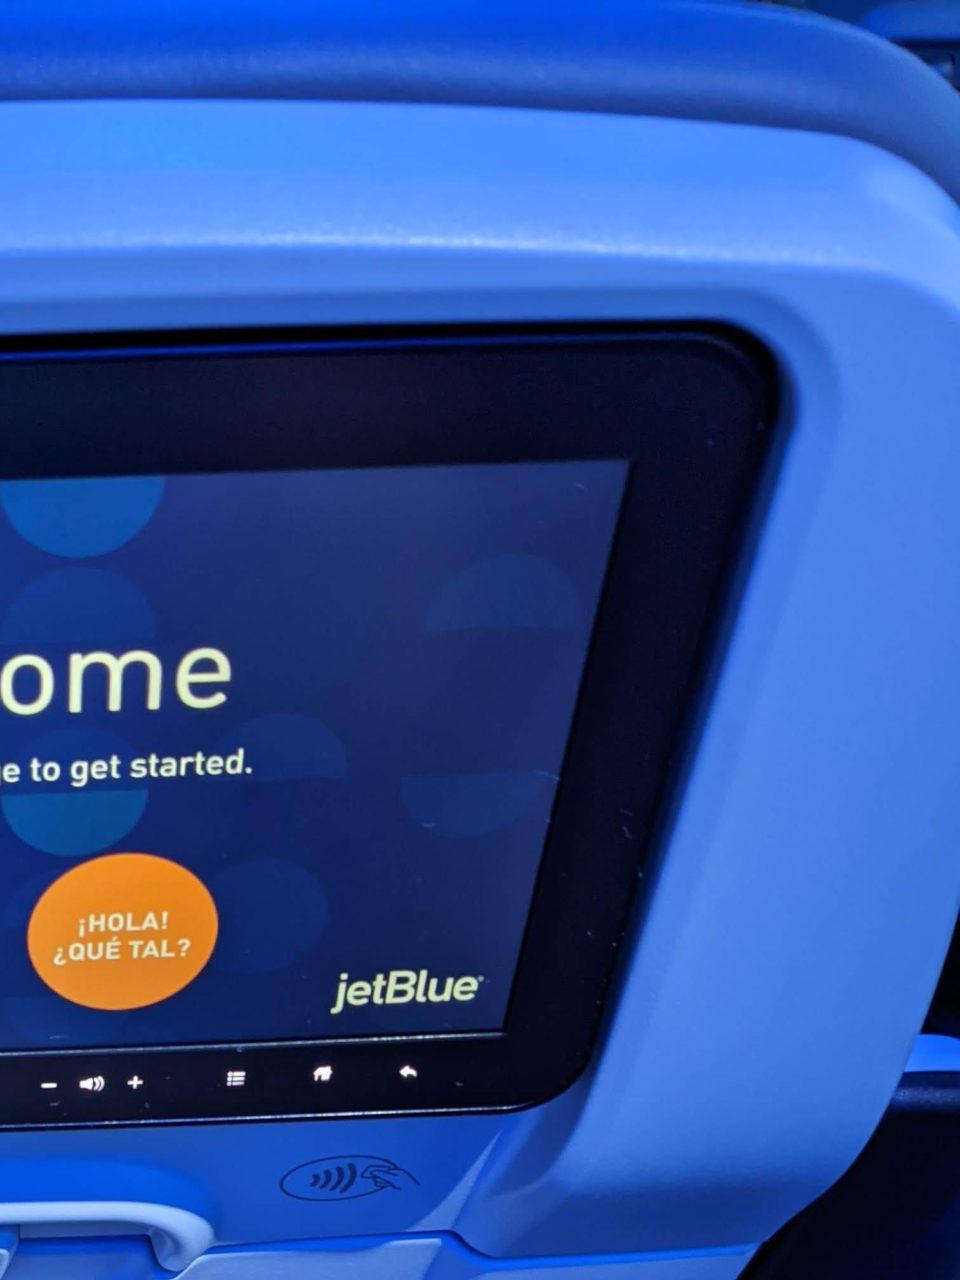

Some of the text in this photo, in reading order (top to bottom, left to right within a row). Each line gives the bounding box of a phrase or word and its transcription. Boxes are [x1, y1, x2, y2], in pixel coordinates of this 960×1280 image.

[29, 757, 61, 783] to
[70, 754, 122, 788] get
[129, 747, 253, 778] started.
[76, 911, 170, 937] ¡HOLA!
[52, 937, 191, 965] ¿QUÉ TAL?
[329, 968, 480, 1015] jetBlue
